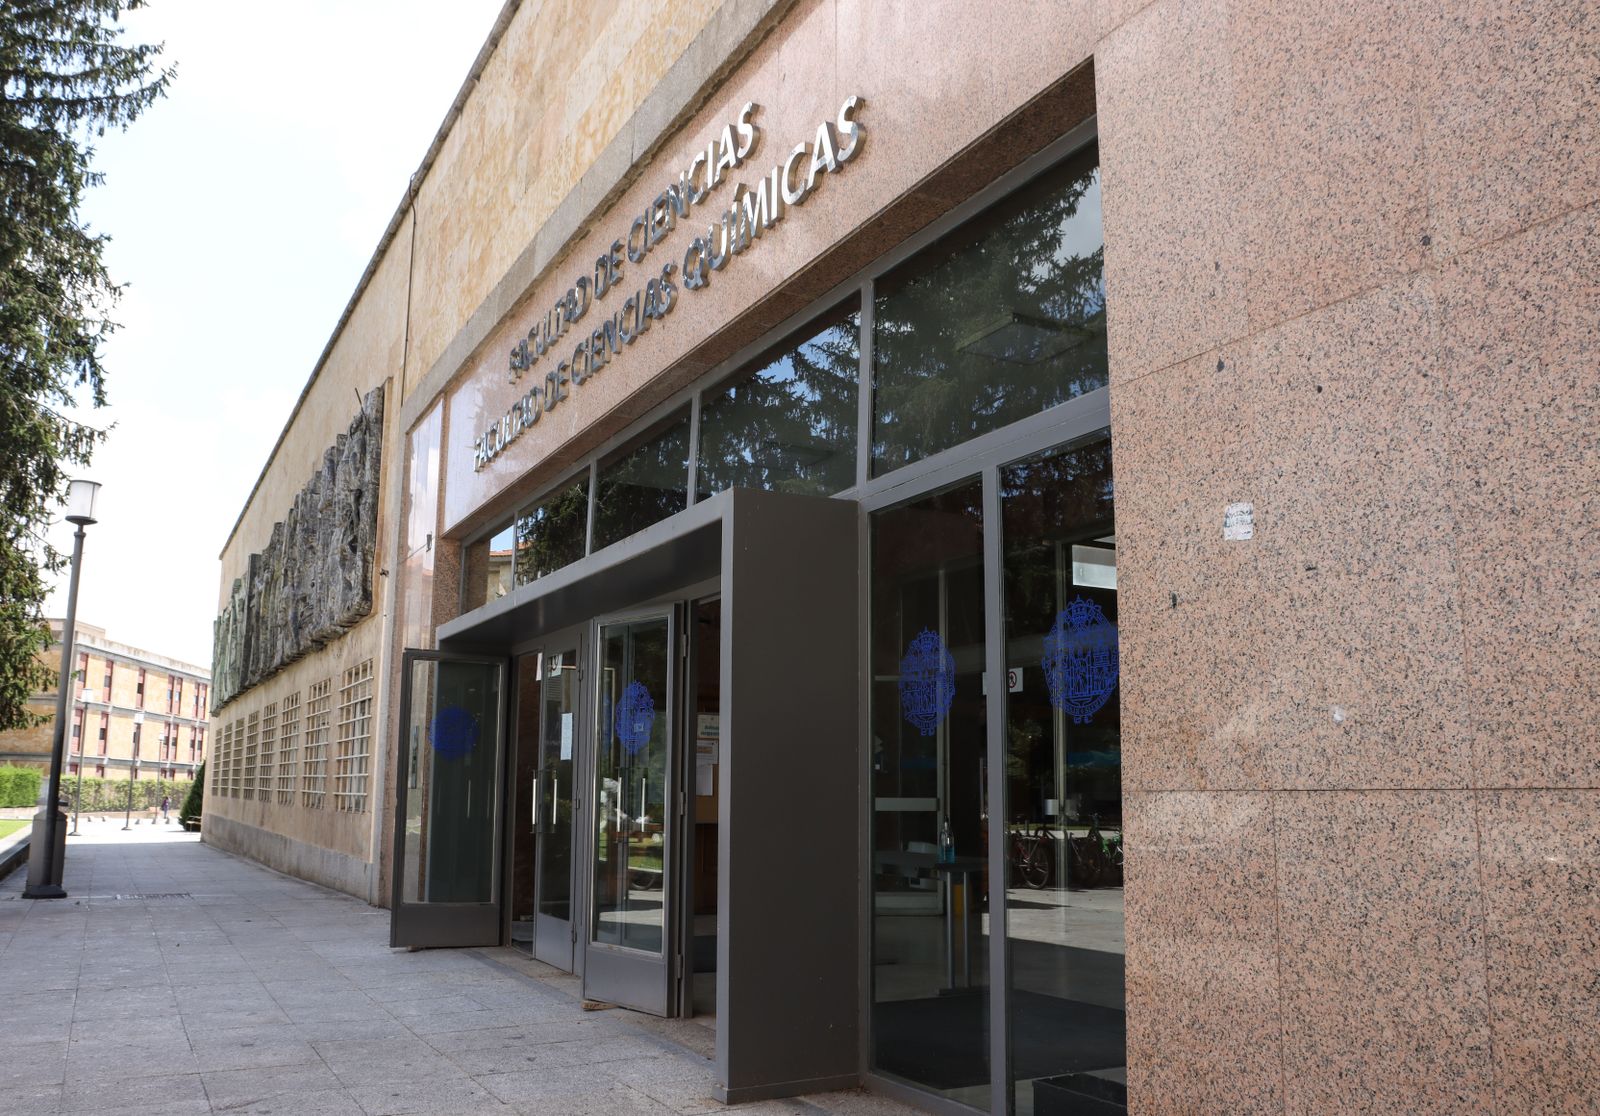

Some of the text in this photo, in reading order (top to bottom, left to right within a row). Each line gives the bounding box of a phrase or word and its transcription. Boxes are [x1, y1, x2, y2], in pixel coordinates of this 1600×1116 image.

[474, 95, 866, 472] FACULTAD DE CIENCIAS QUÍMICAS
[595, 239, 625, 299] DE
[628, 101, 760, 263] CIENCIAS
